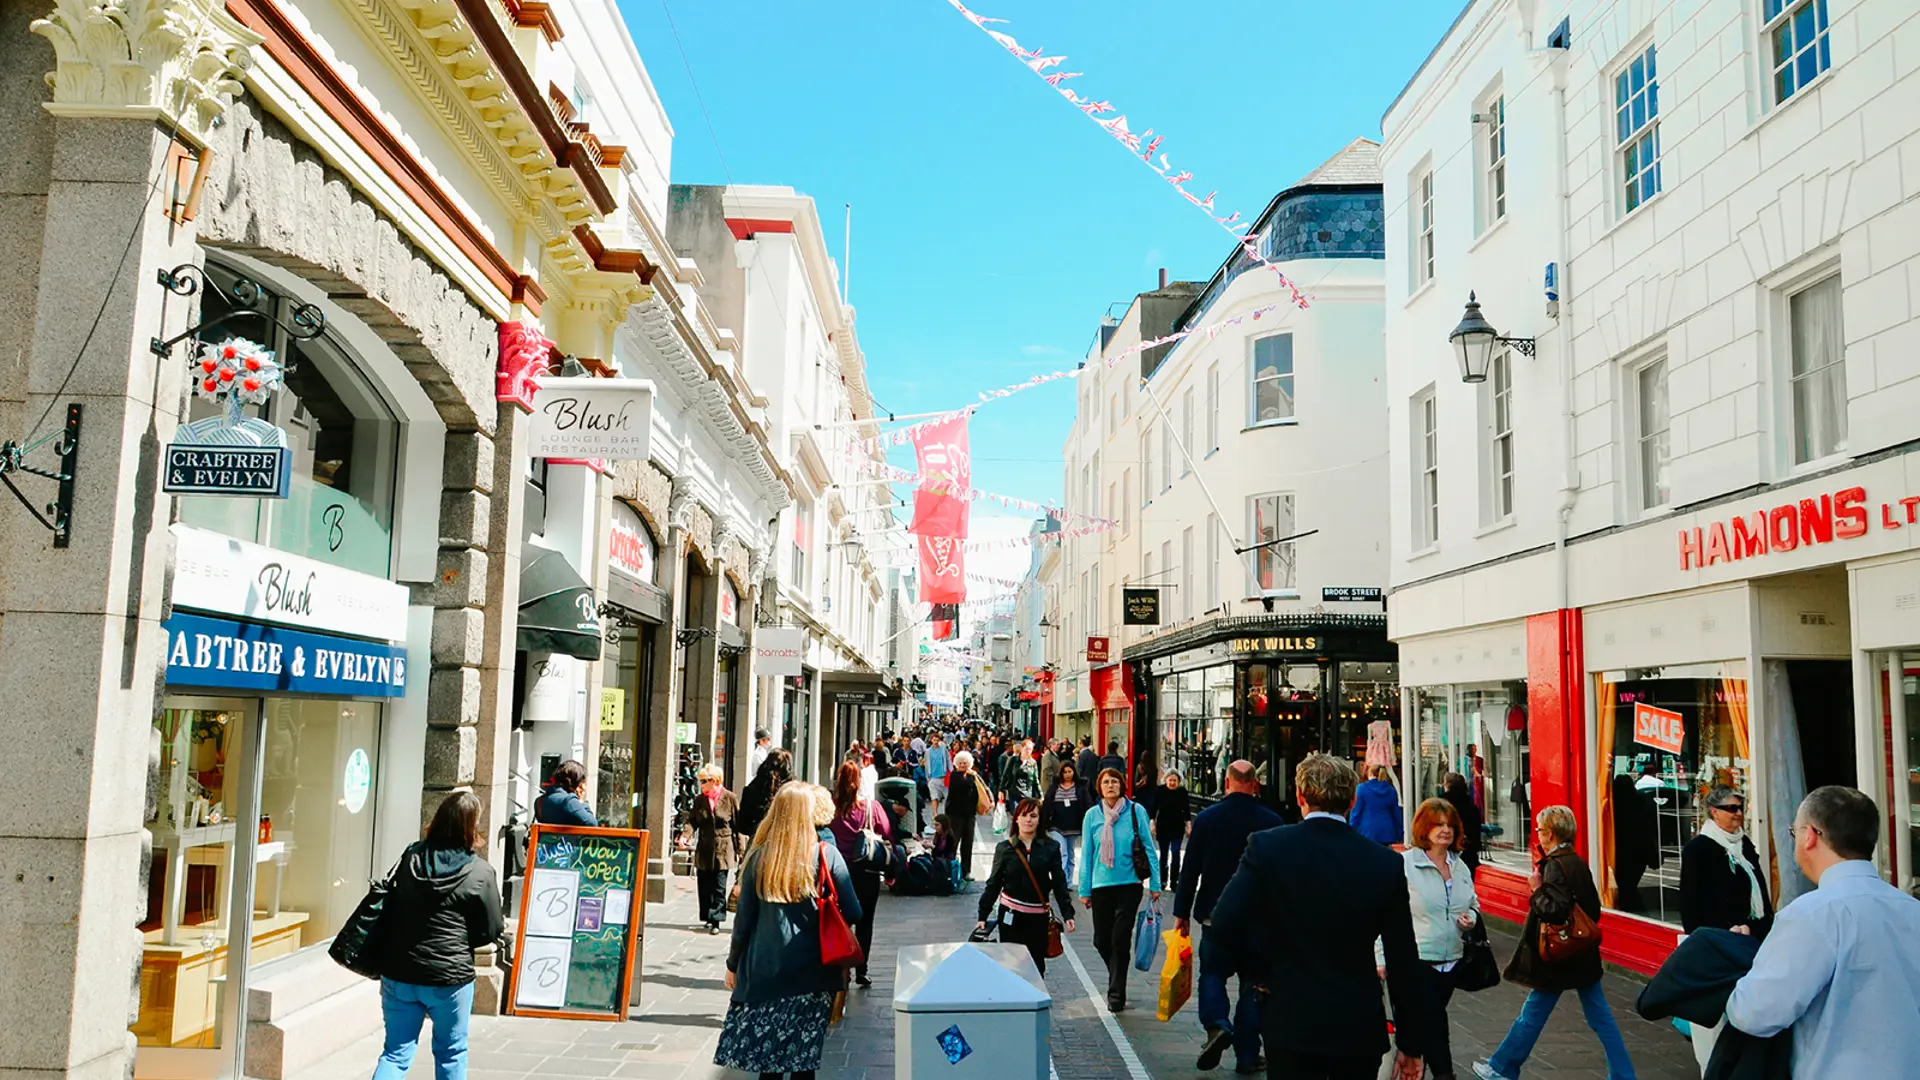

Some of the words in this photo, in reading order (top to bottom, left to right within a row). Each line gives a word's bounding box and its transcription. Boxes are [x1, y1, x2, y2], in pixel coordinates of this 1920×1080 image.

[543, 397, 635, 431] Blush
[540, 444, 639, 455] RESTAURANT
[541, 435, 602, 443] LOUNGE
[610, 436, 640, 444] BAR
[172, 451, 275, 470] CRABTREE
[171, 468, 186, 484] &
[193, 469, 272, 487] EVELYN
[322, 503, 345, 552] B
[1678, 486, 1868, 571] HAMONS
[258, 562, 317, 616] Blush
[1324, 588, 1349, 596] BROOK
[1351, 588, 1379, 596] STREET
[757, 648, 799, 657] barratts
[1233, 638, 1260, 652] JACK
[1264, 637, 1316, 650] WILLS
[290, 645, 306, 677] &
[314, 648, 391, 684] EVELYN
[1638, 711, 1681, 746] SALE
[536, 836, 574, 865] Blush
[584, 839, 621, 859] Now
[536, 887, 570, 918] B
[527, 956, 561, 988] B
